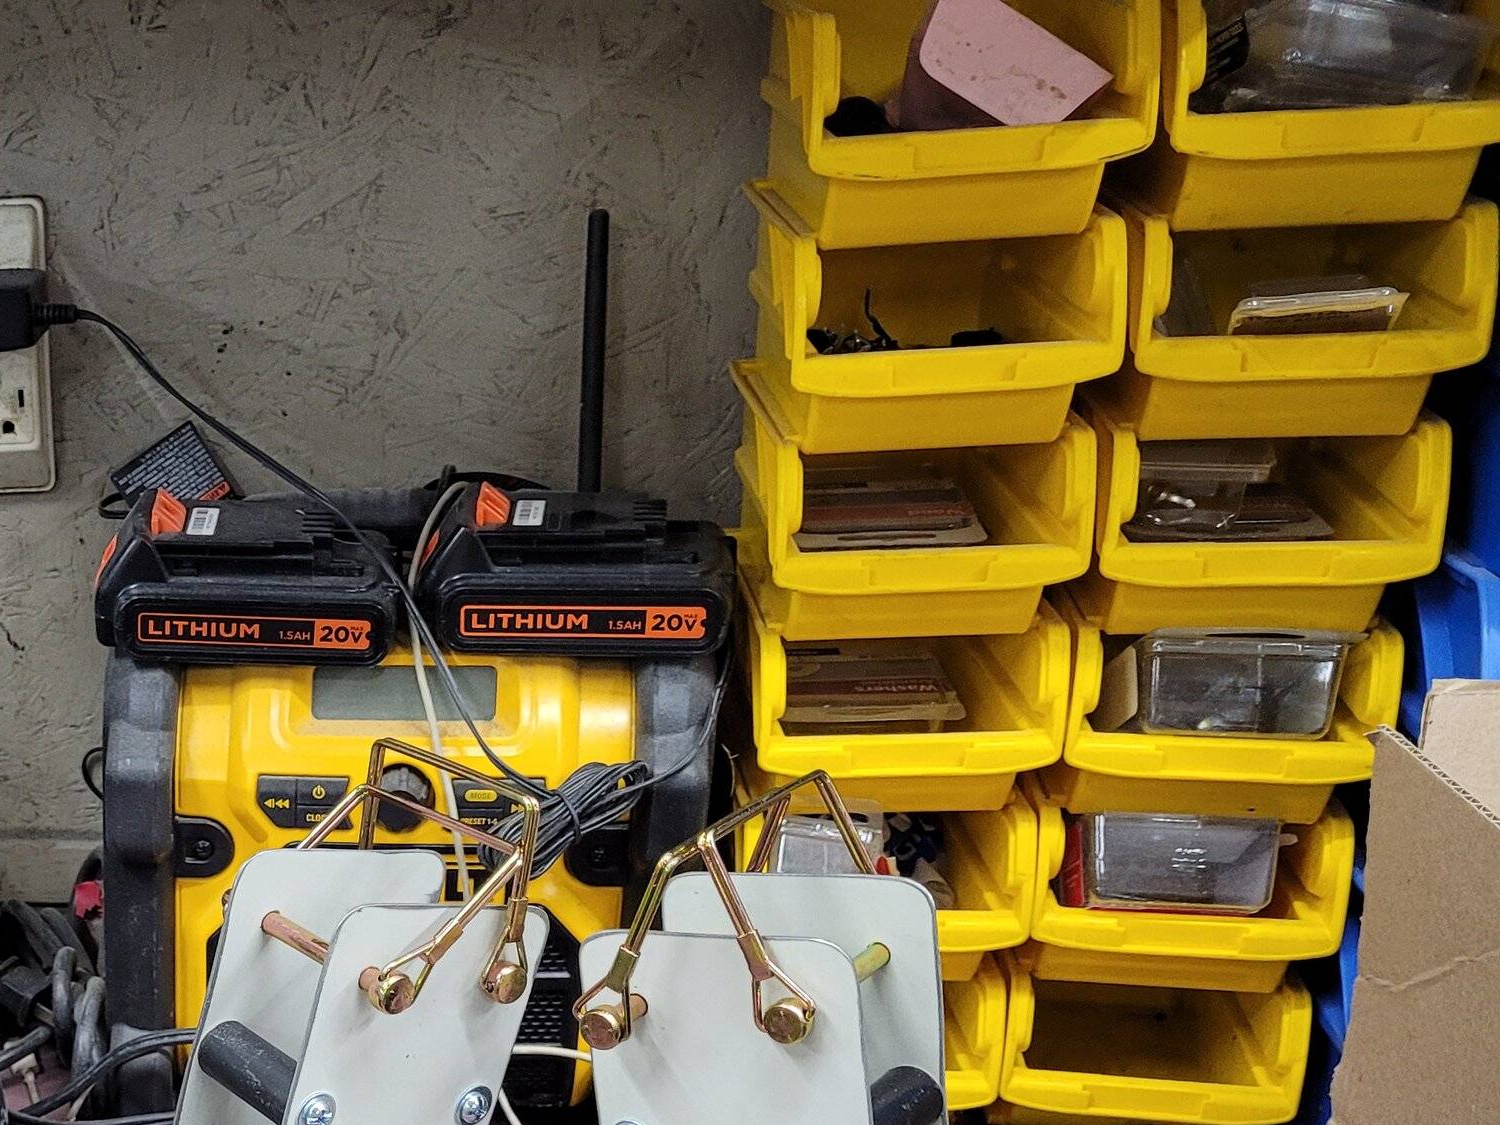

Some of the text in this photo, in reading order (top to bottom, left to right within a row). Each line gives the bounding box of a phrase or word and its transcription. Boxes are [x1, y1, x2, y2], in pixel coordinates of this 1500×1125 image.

[148, 619, 364, 644] LITHIUM 1.5AH 20V
[471, 613, 698, 632] LITHIUM 1.5AH 20V
[306, 813, 325, 822] CLO
